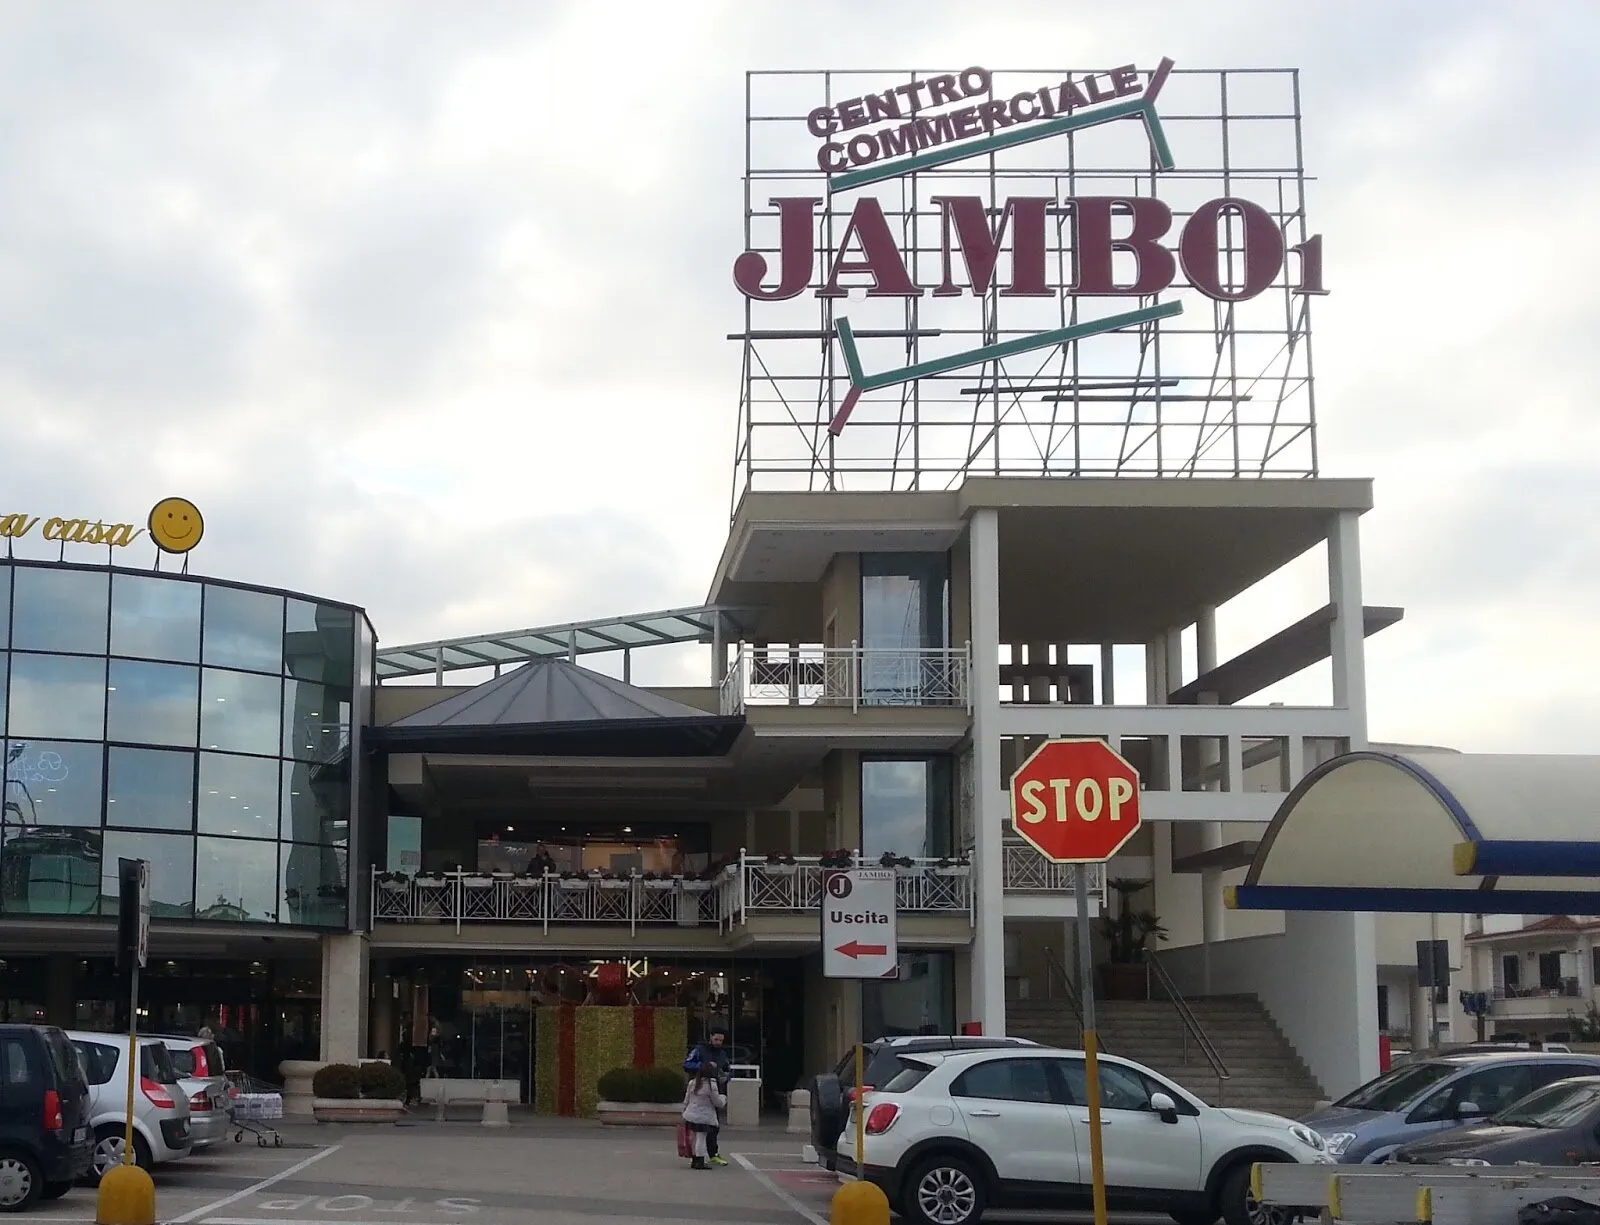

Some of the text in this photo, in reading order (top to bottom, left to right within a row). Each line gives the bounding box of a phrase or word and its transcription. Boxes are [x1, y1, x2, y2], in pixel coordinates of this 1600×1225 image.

[807, 65, 993, 138] CENTRO
[816, 63, 1144, 173] COMMERCIALE
[42, 516, 146, 547] casa
[1020, 776, 1134, 824] STOP
[830, 910, 889, 924] Uscita
[256, 1193, 482, 1215] STOP
